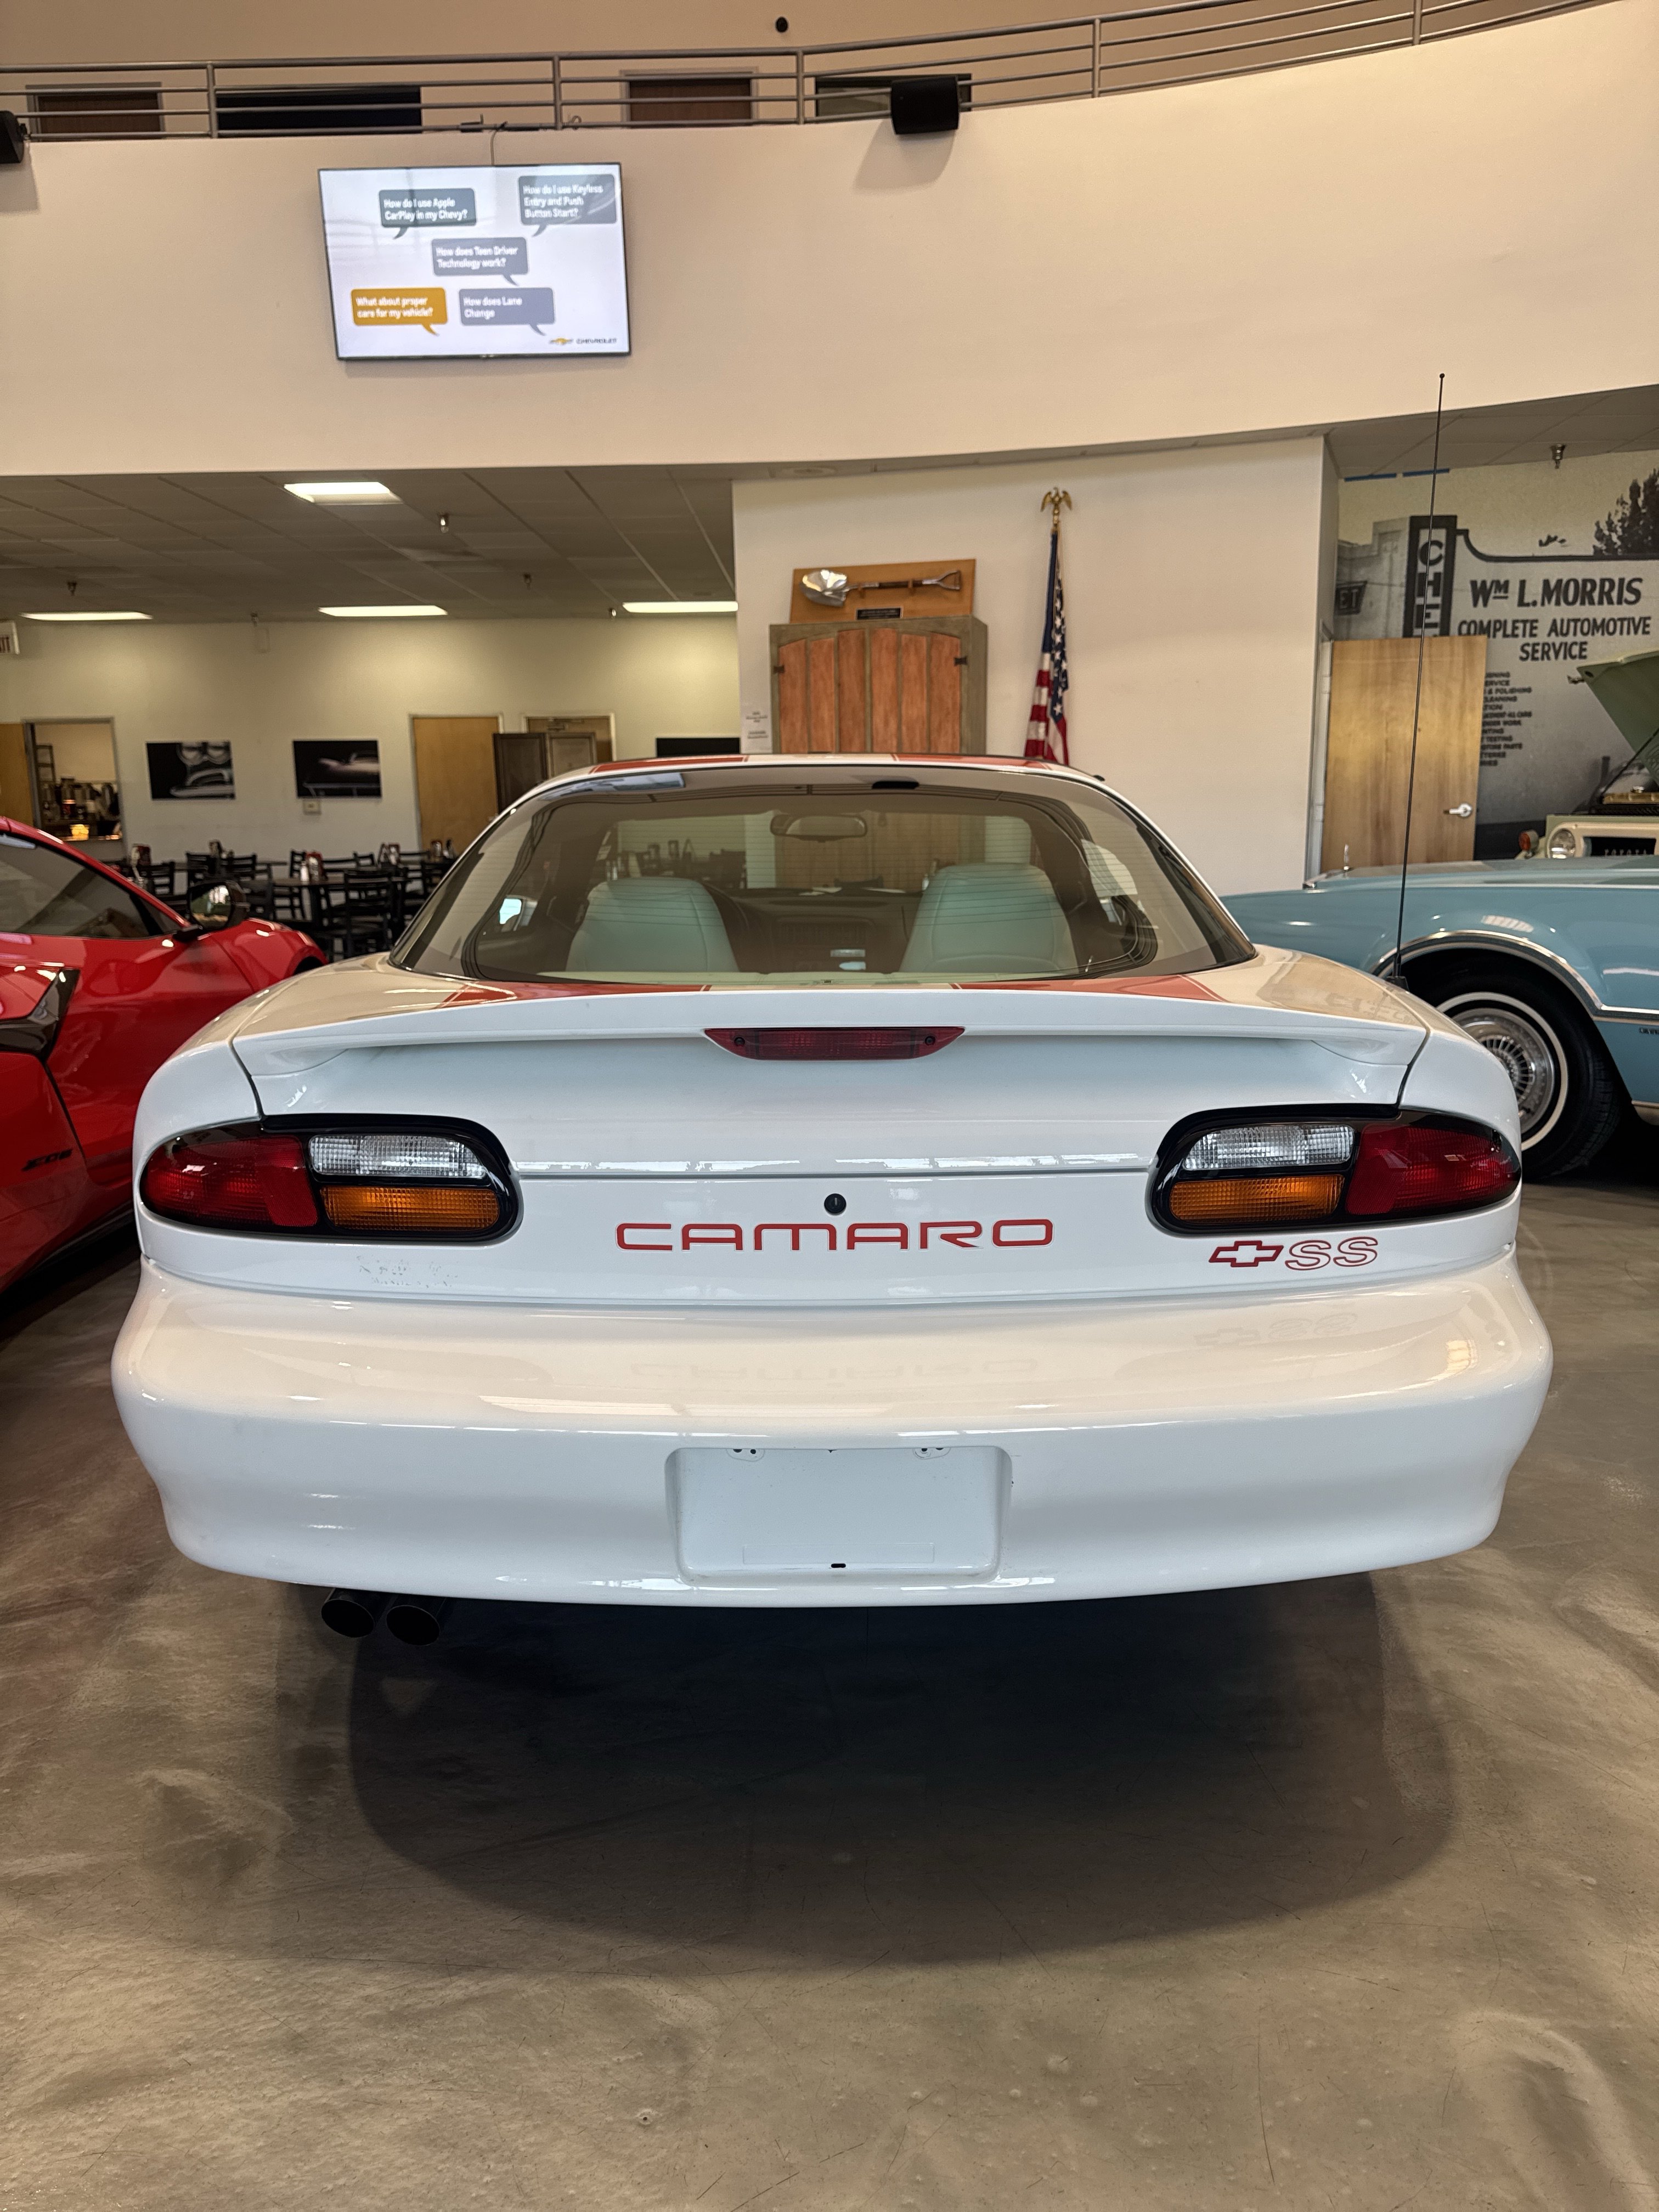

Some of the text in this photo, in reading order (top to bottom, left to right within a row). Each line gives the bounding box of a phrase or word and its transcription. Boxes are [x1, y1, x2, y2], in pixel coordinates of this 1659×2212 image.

[523, 185, 540, 194] How
[542, 185, 551, 194] do
[572, 184, 603, 196] Keyless
[384, 198, 455, 209] How do I use Apple
[524, 196, 584, 208] Entry and Push
[385, 209, 468, 222] CarPlay in my Chevy?
[524, 208, 552, 218] Button
[436, 245, 518, 256] How does Teen Driver
[437, 258, 506, 269] Technology work?
[356, 296, 427, 308] What about proper
[463, 296, 522, 306] How does Lane
[376, 308, 387, 317] for
[388, 310, 402, 319] my
[402, 307, 433, 317] vehicle?
[464, 308, 495, 320] Change
[1413, 540, 1443, 636] CHE
[1541, 577, 1643, 607] MORRIS
[1458, 616, 1651, 639] COMPLETE AUTOMOTIVE
[1519, 641, 1588, 662] SERVICE
[616, 1218, 1054, 1252] CAMARO
[1285, 1236, 1379, 1271] SS
